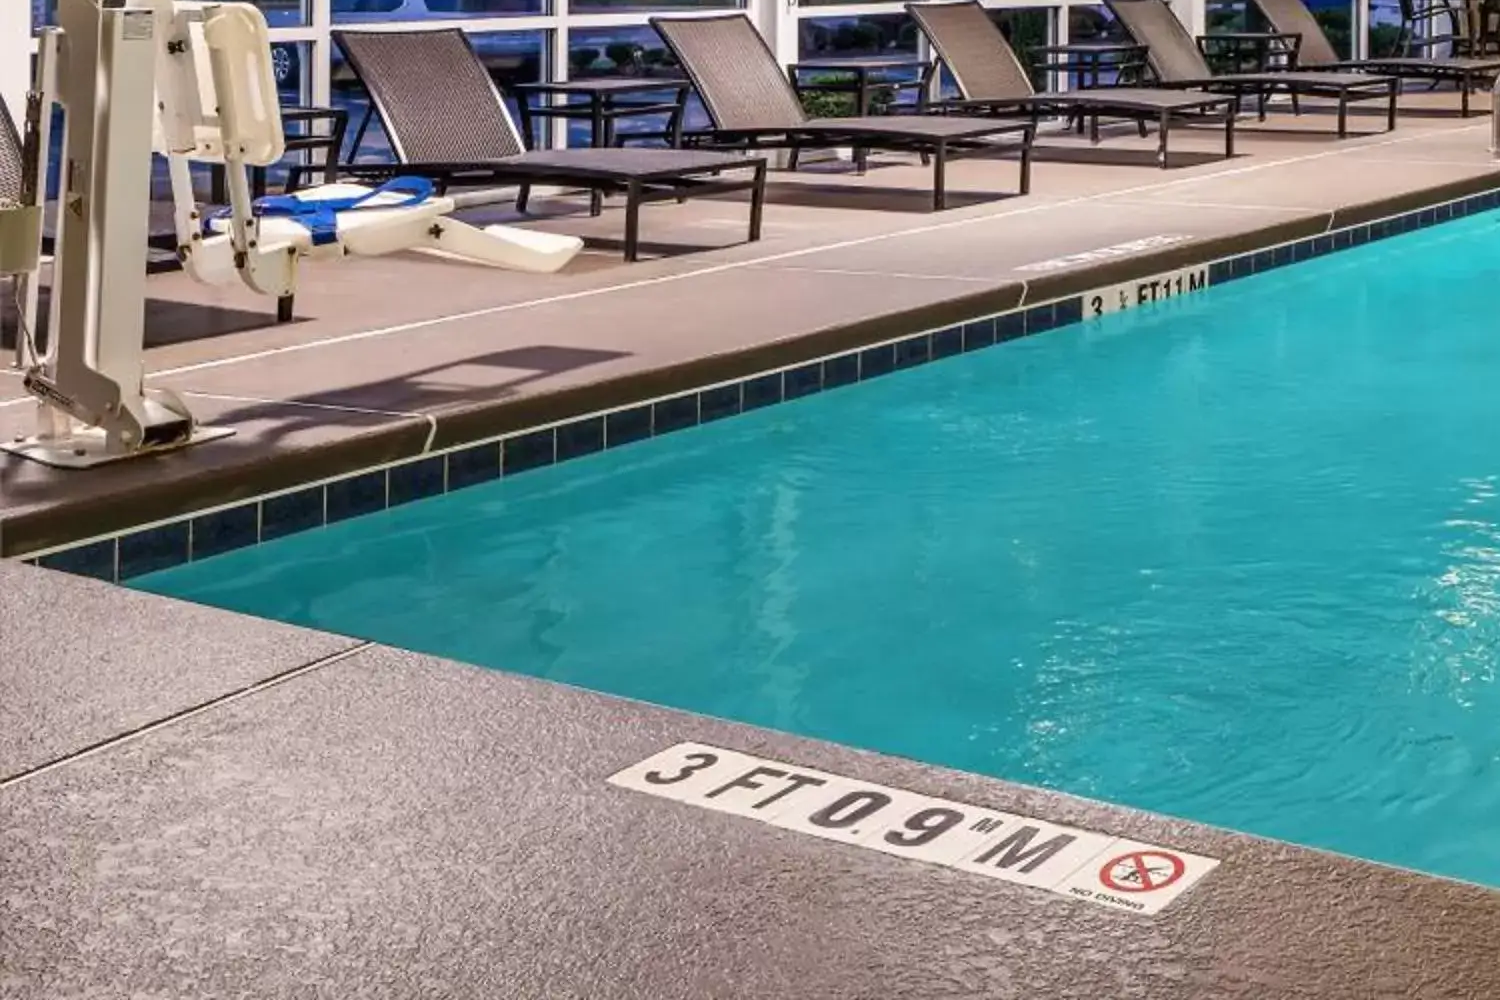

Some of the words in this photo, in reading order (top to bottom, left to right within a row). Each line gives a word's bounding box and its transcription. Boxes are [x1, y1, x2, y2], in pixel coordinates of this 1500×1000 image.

[644, 753, 719, 786] 3
[704, 766, 827, 809] FT
[973, 825, 1078, 873] M
[1068, 887, 1093, 897] NO
